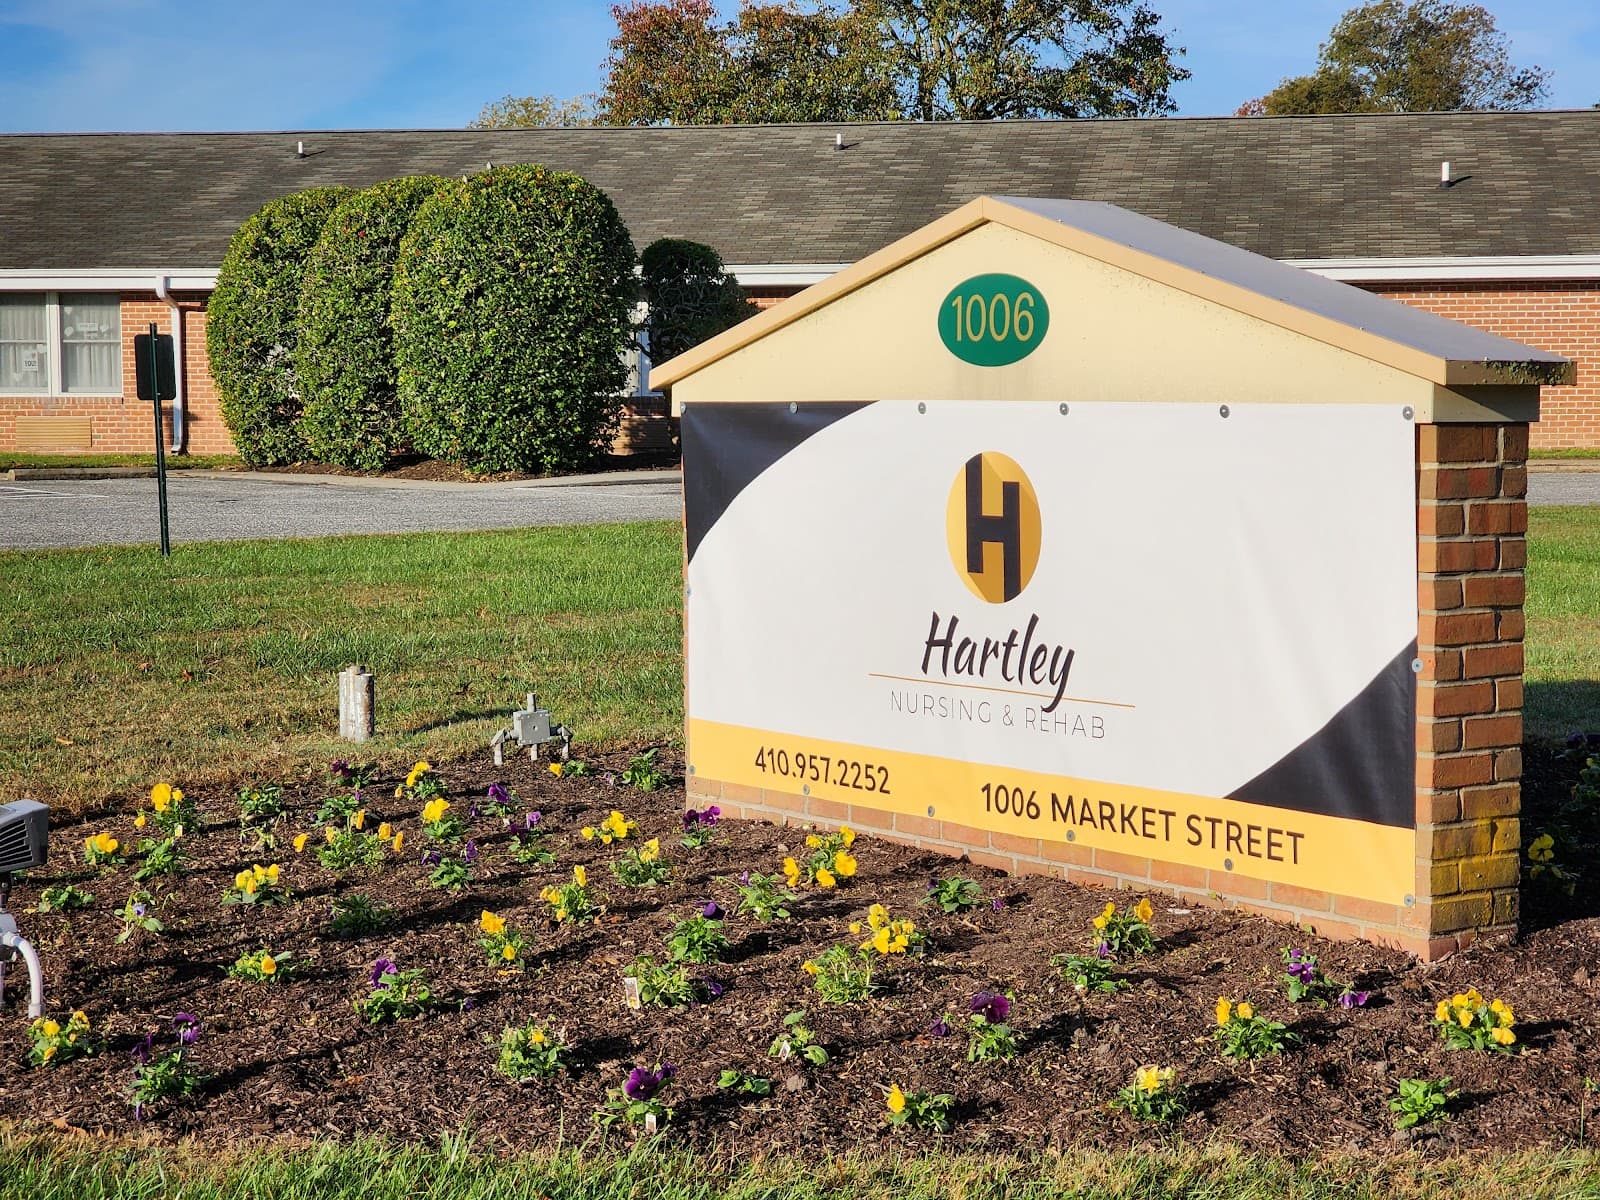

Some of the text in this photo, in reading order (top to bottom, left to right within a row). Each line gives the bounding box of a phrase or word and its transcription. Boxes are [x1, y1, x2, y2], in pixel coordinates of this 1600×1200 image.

[952, 292, 1034, 342] 1006
[965, 453, 1021, 603] H
[921, 611, 1075, 713] Hartley
[891, 690, 1105, 739] NURSING & REHAB
[755, 746, 891, 794] 410.957.2252
[981, 783, 1305, 865] 1006 MARKET STREET
